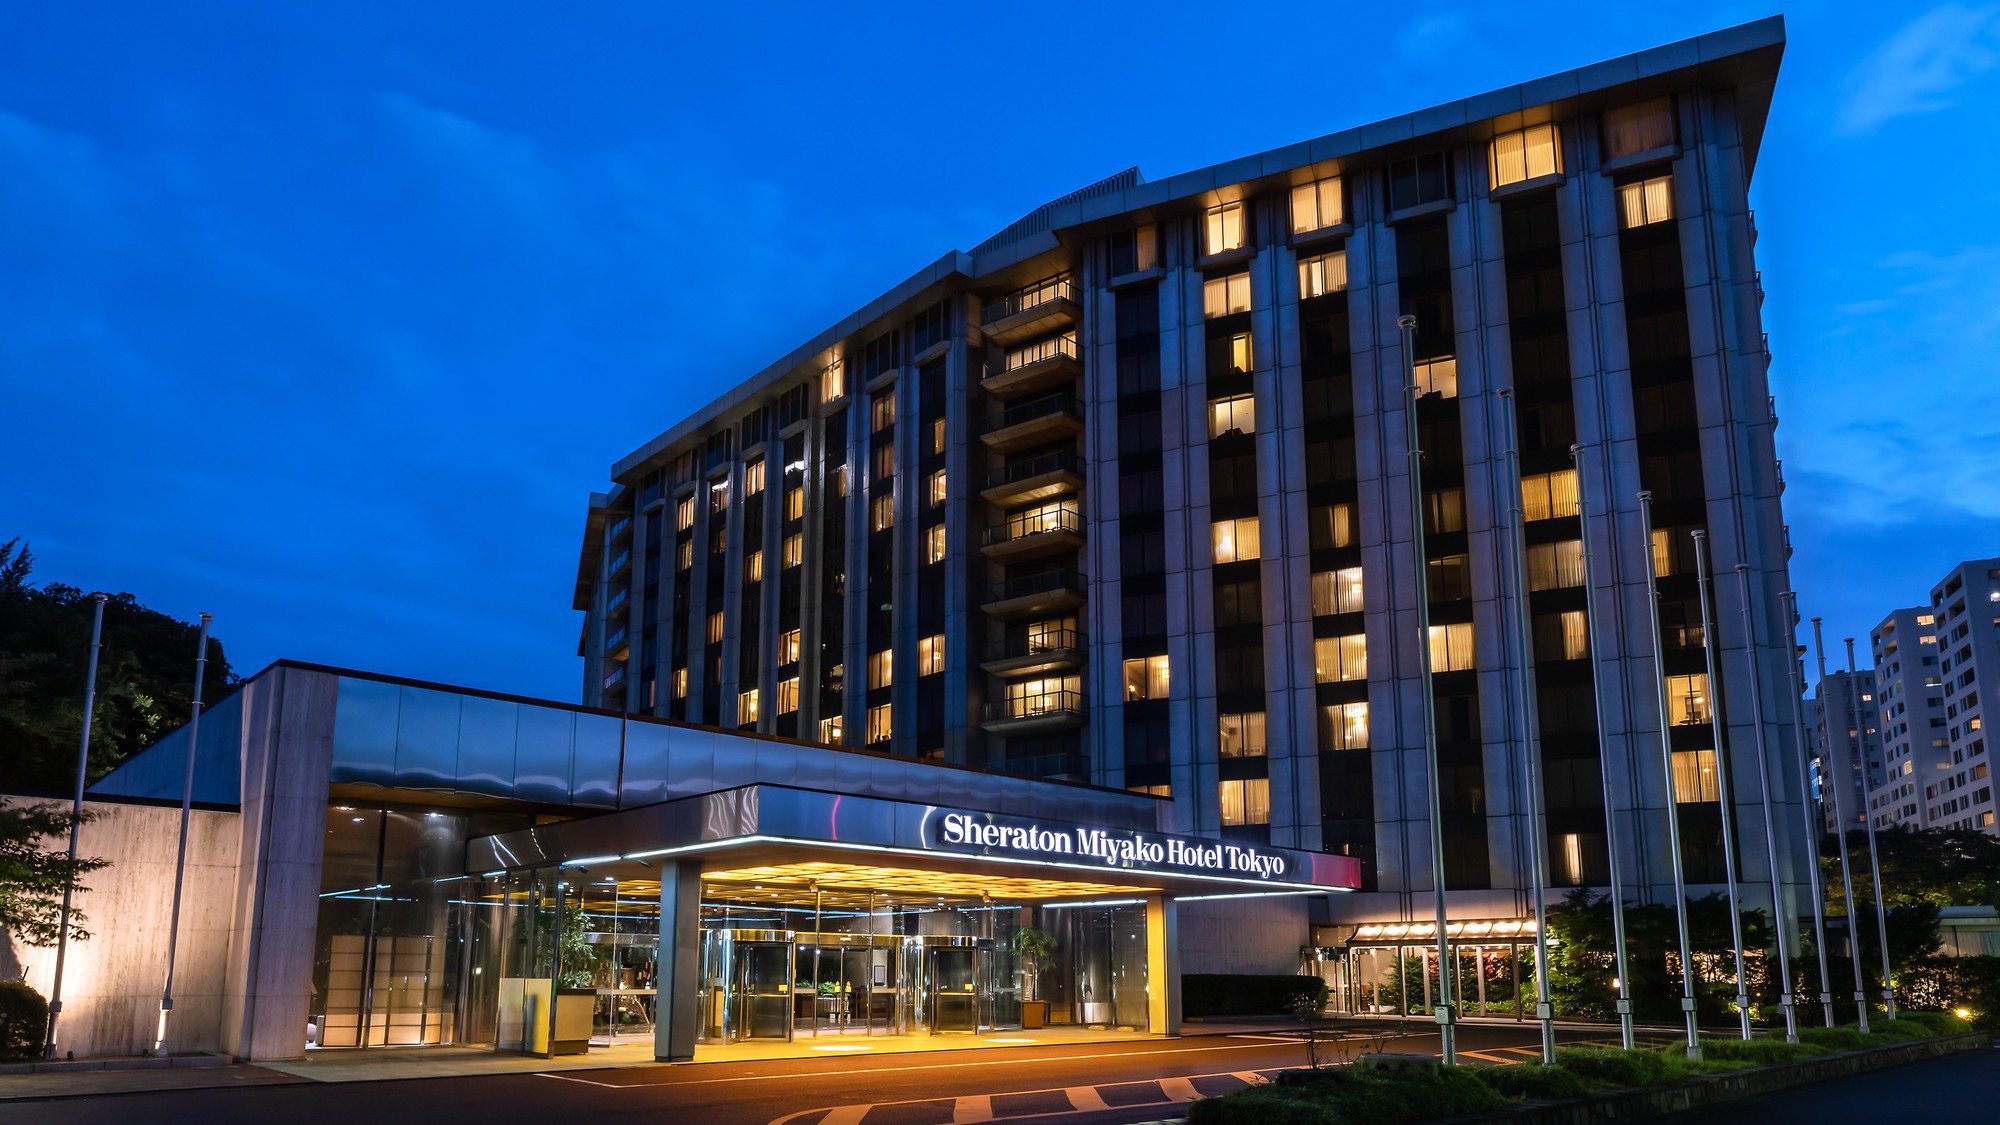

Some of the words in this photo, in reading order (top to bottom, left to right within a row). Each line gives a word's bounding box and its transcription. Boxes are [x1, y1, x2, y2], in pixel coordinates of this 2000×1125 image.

[944, 813, 1072, 854] Sheraton
[1076, 828, 1164, 865] Miyako
[1167, 839, 1223, 868] Hotel
[1225, 846, 1285, 878] Tokyo
